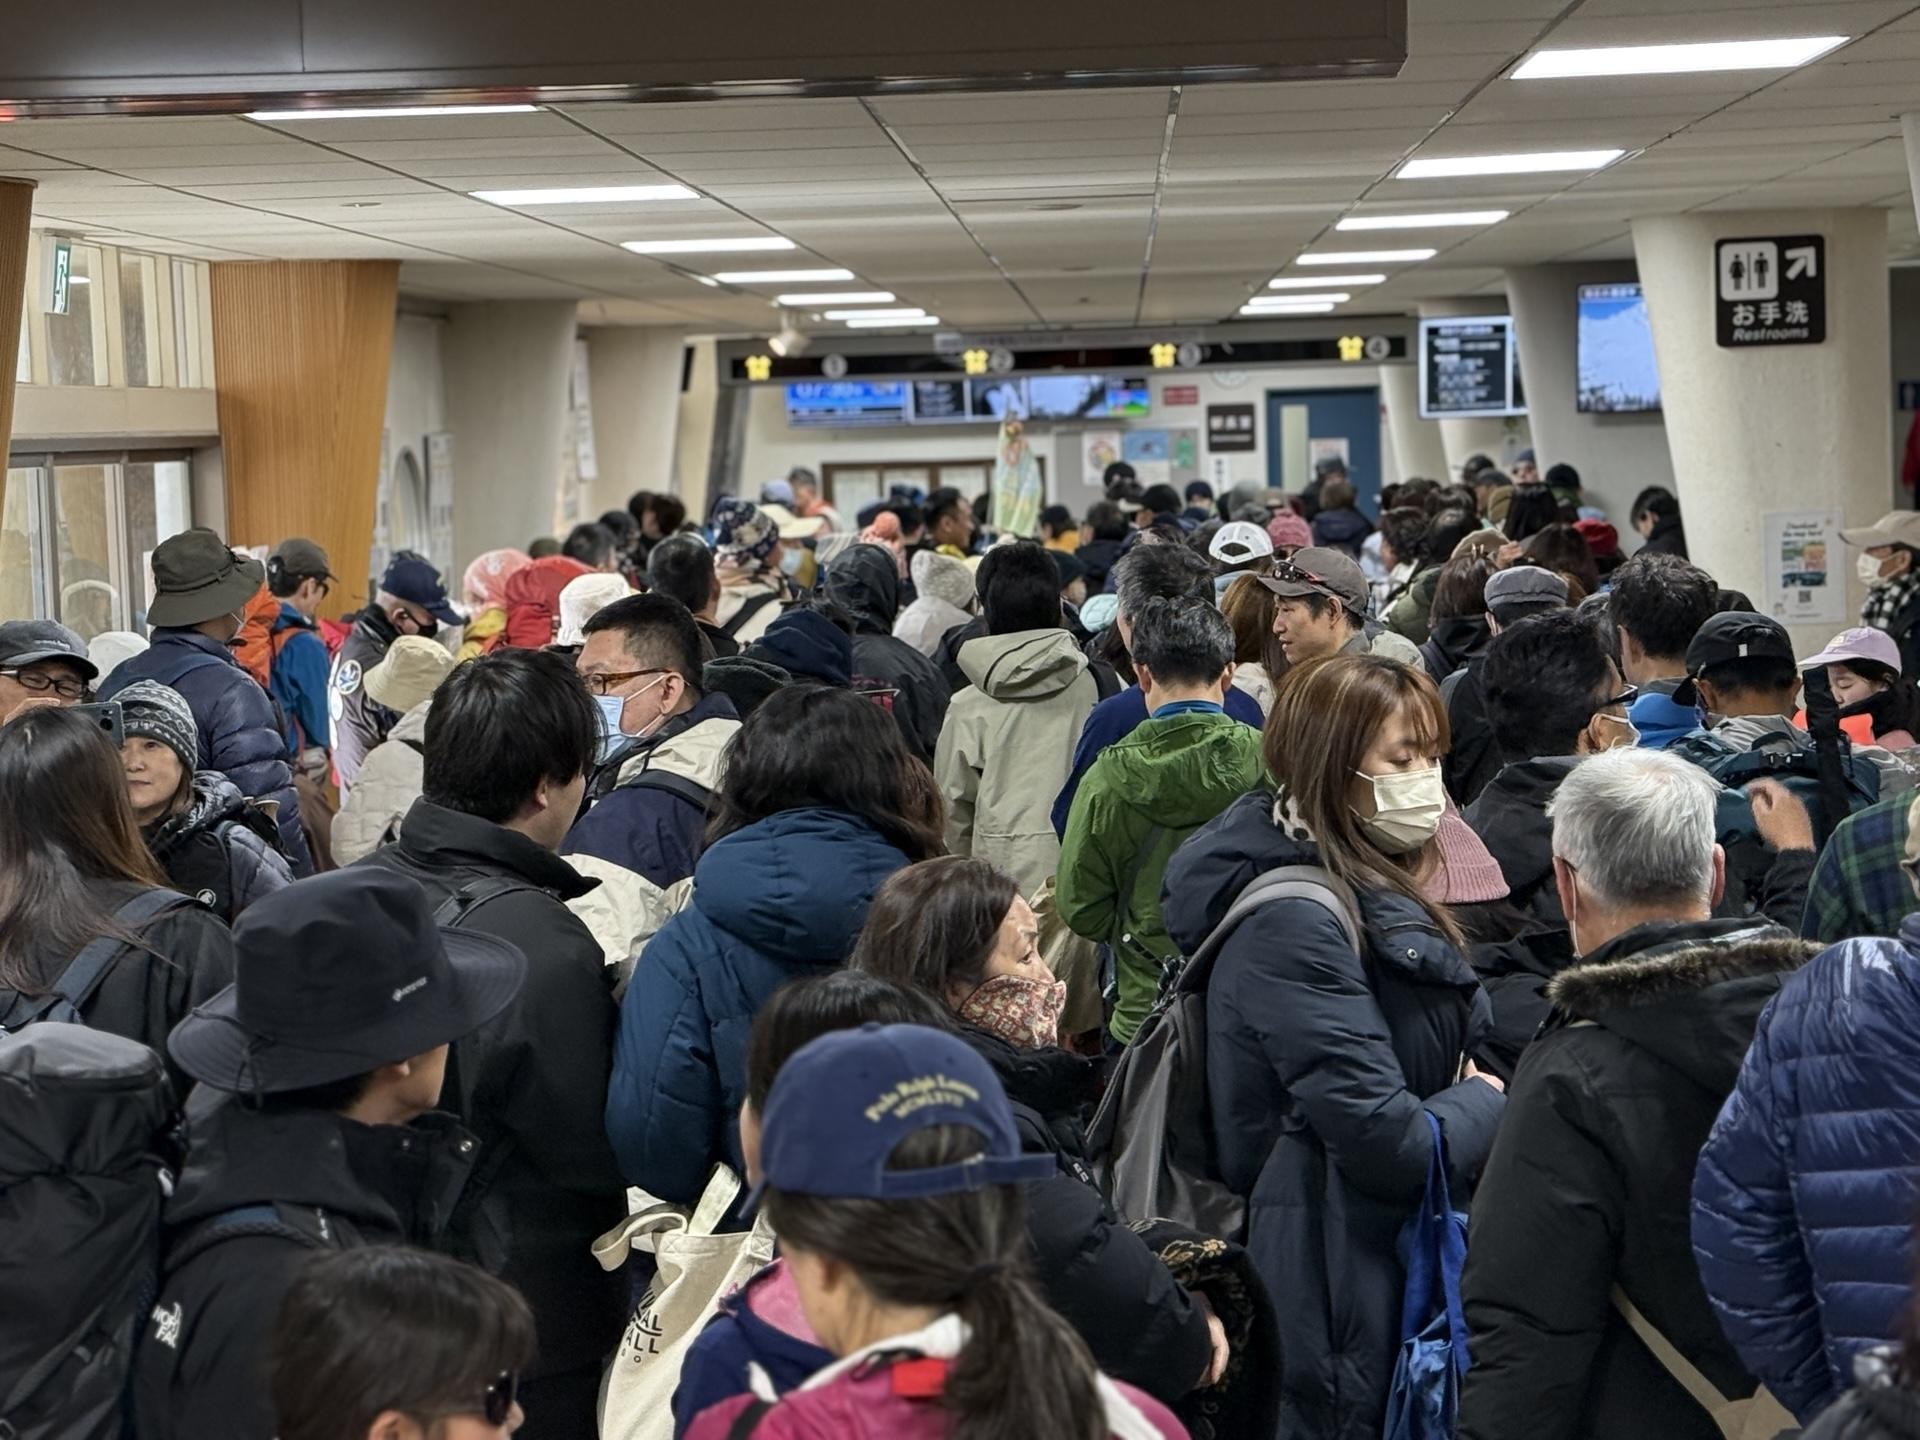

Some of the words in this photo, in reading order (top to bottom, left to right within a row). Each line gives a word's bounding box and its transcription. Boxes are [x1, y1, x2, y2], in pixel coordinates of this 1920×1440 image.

[1732, 301, 1809, 326] お手洗
[1733, 327, 1809, 341] Restrooms
[864, 1092, 899, 1122] Polo
